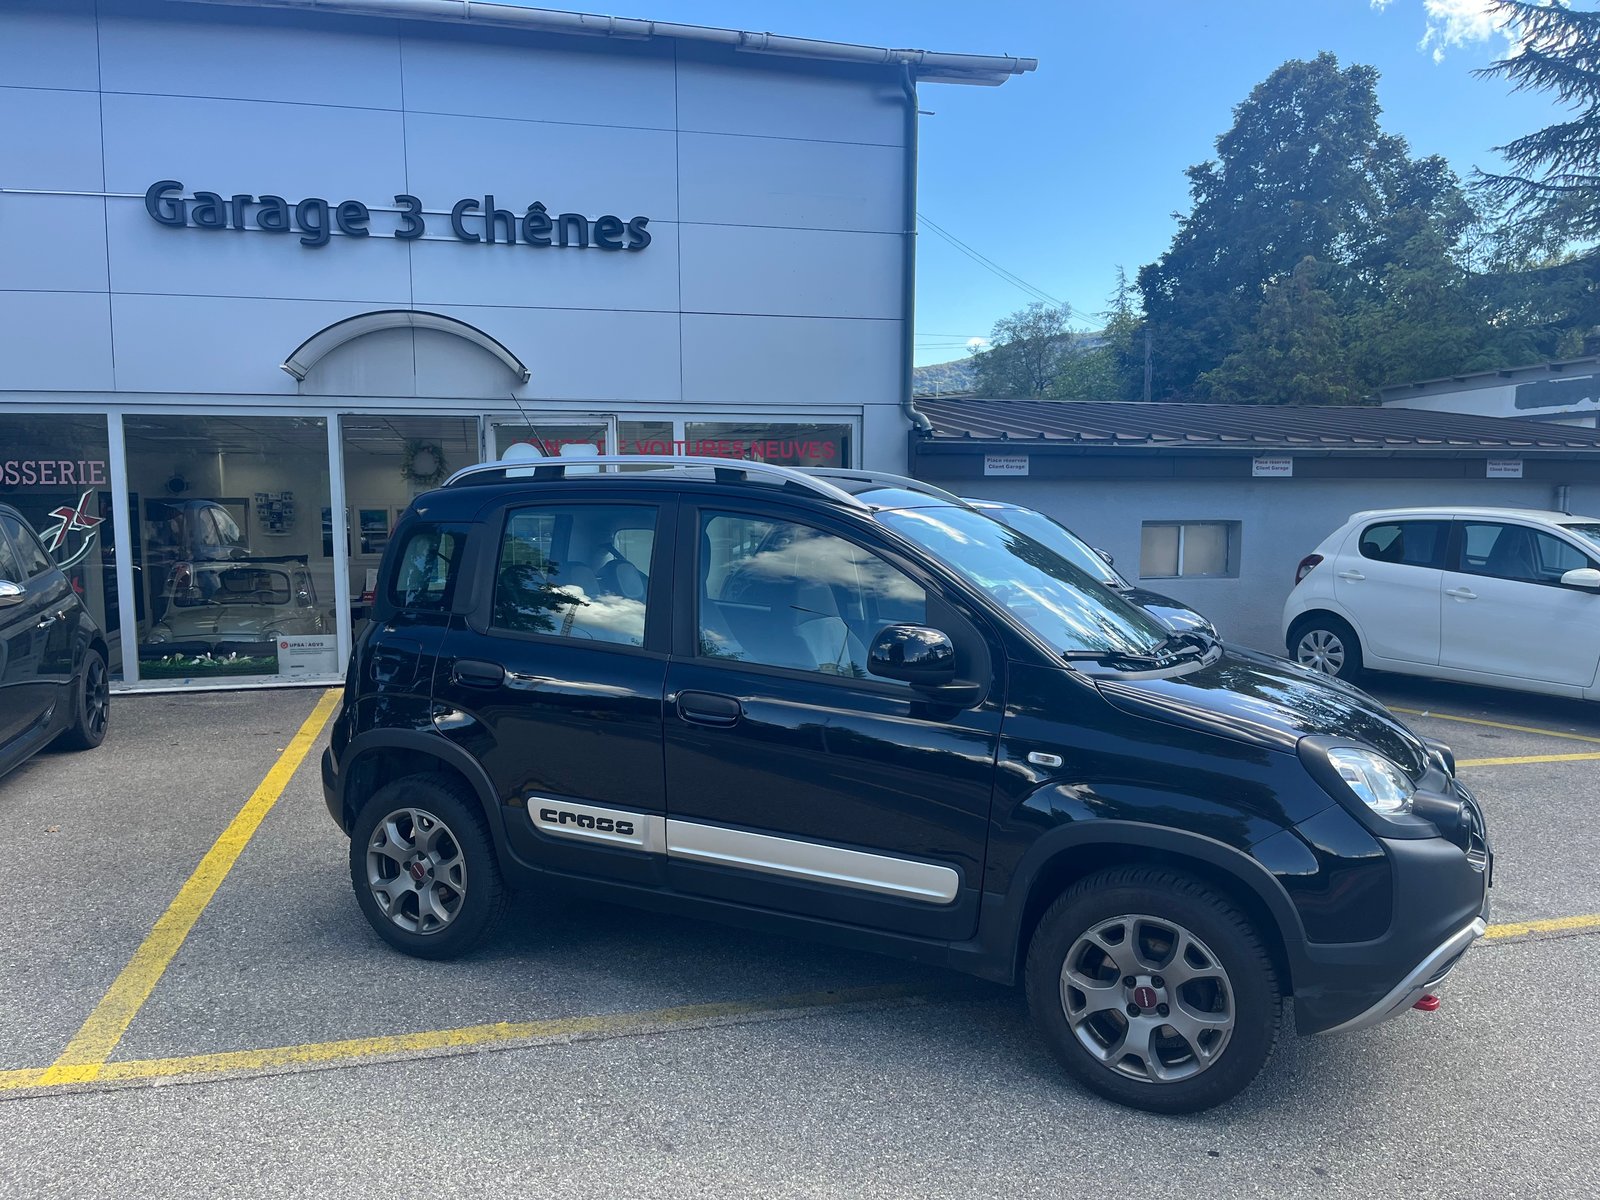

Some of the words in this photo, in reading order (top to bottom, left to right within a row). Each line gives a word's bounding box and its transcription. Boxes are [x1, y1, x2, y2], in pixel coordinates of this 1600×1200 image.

[145, 179, 370, 247] Garage
[394, 193, 425, 241] 3
[451, 194, 652, 252] Chênes
[636, 440, 744, 458] VOITURES
[751, 440, 836, 459] NEUVES
[0, 460, 106, 485] SSERIE
[540, 808, 634, 836] cross
